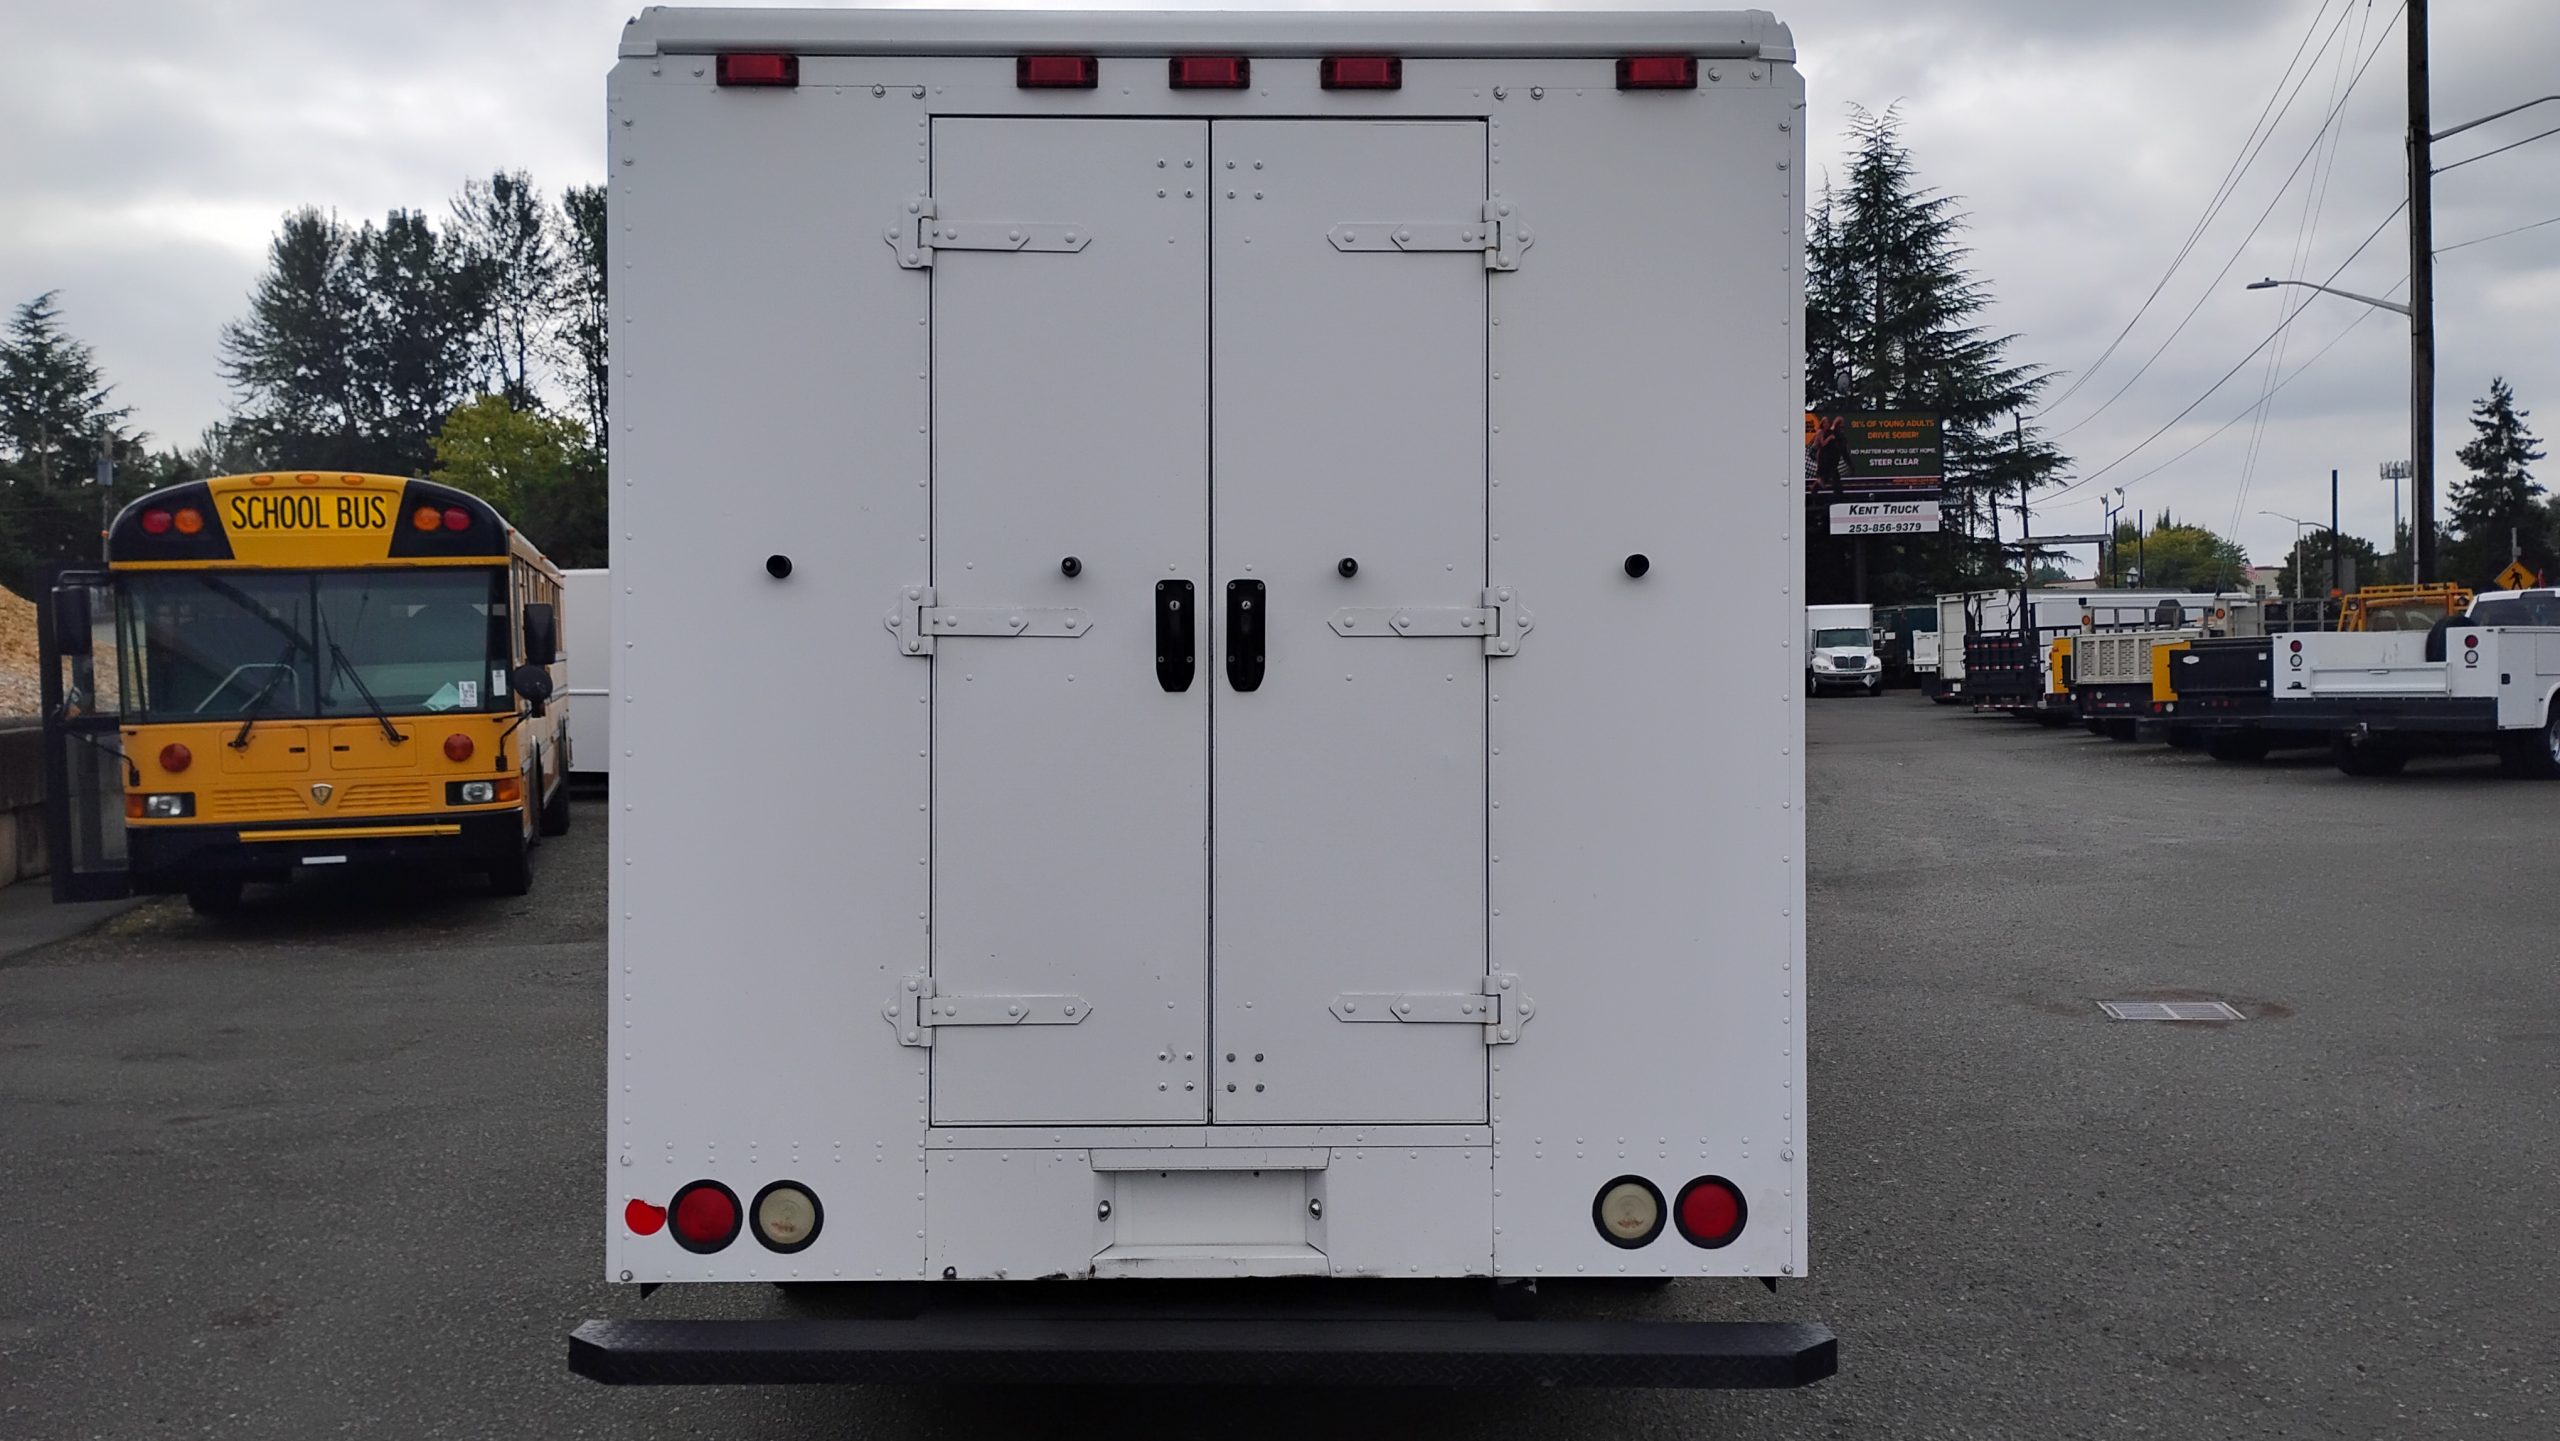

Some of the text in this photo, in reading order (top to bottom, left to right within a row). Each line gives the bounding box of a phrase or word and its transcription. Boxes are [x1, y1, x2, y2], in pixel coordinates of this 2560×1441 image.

[1866, 420, 1877, 428] OF
[1879, 420, 1905, 428] YOUNG
[1906, 419, 1934, 427] ADULTS
[1867, 431, 1890, 439] DRIVE
[1869, 457, 1919, 466] STEER CLEAR
[231, 495, 386, 529] SCHOOL BUS
[1849, 504, 1920, 515] KENT TRUCK
[1849, 523, 1922, 533] 253-856-9379
